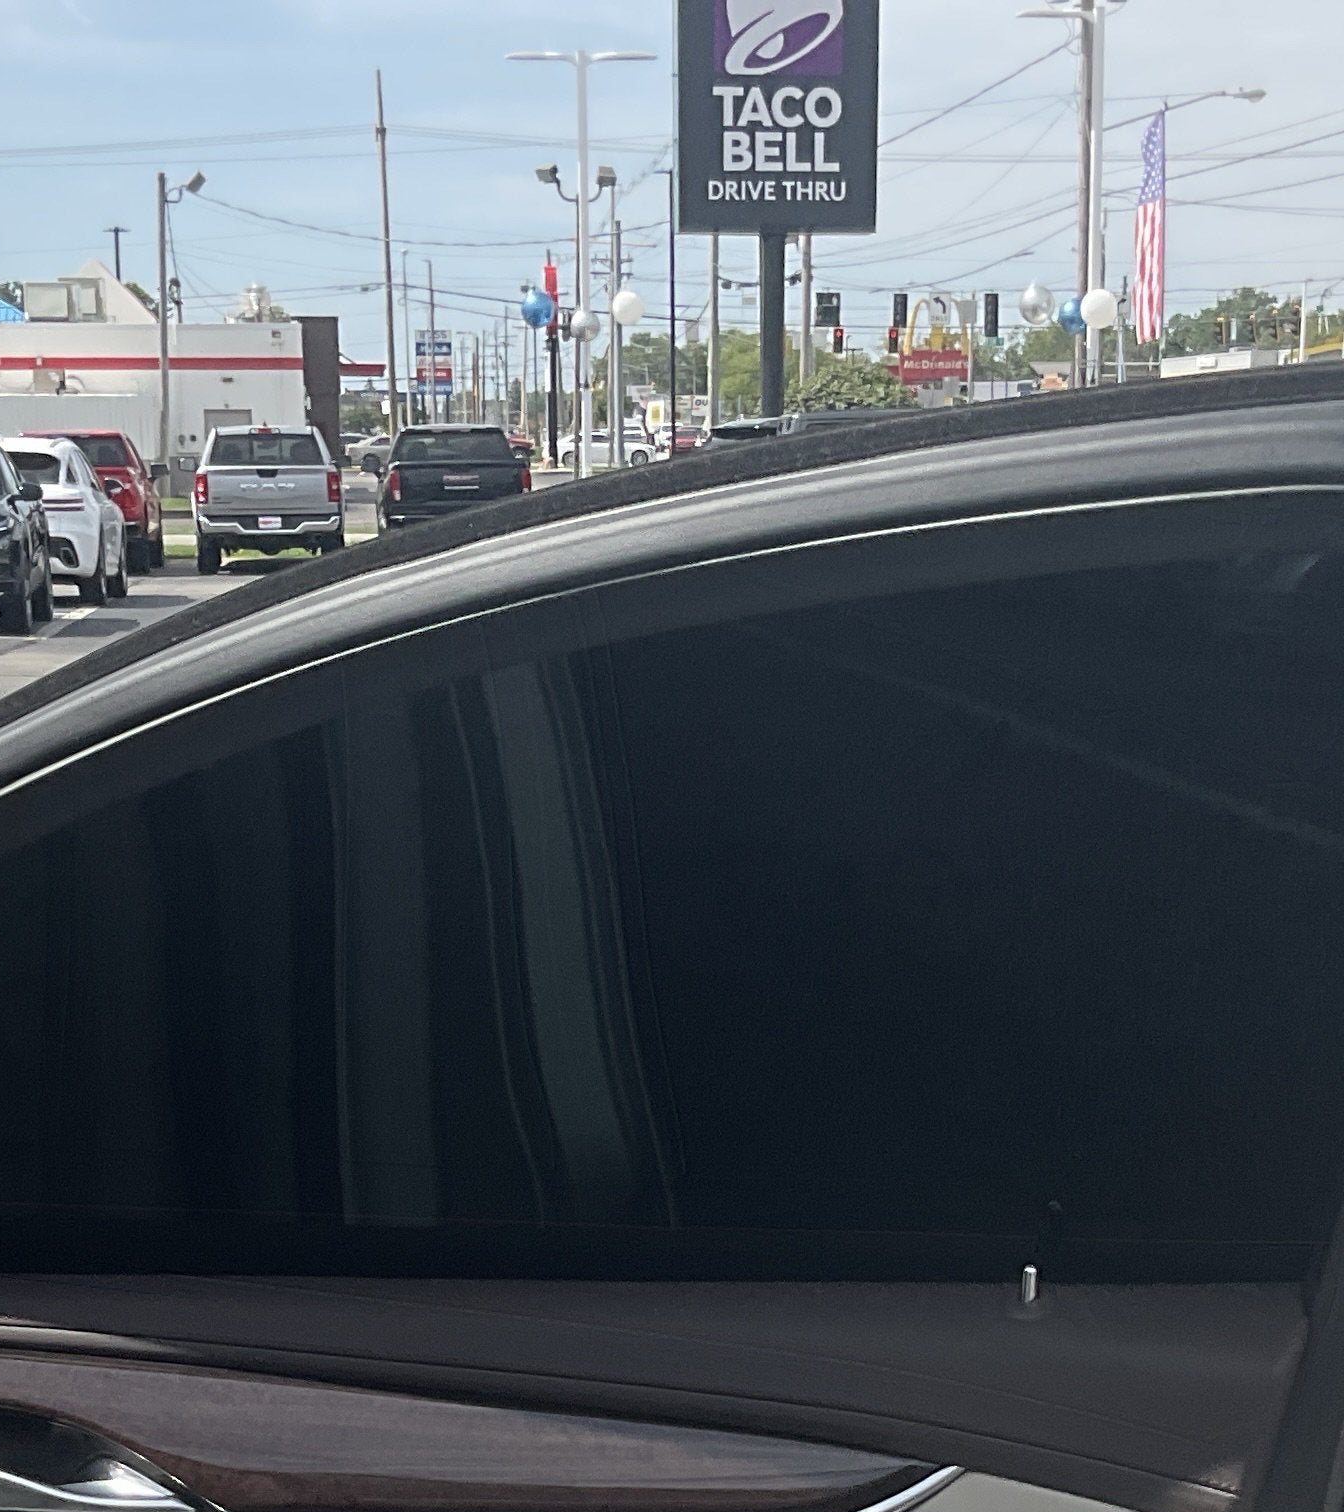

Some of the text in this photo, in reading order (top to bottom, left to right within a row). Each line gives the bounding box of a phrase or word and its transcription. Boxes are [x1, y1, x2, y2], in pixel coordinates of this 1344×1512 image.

[712, 86, 843, 128] TACO
[723, 131, 840, 173] BELL
[708, 180, 847, 201] DRIVE THRU
